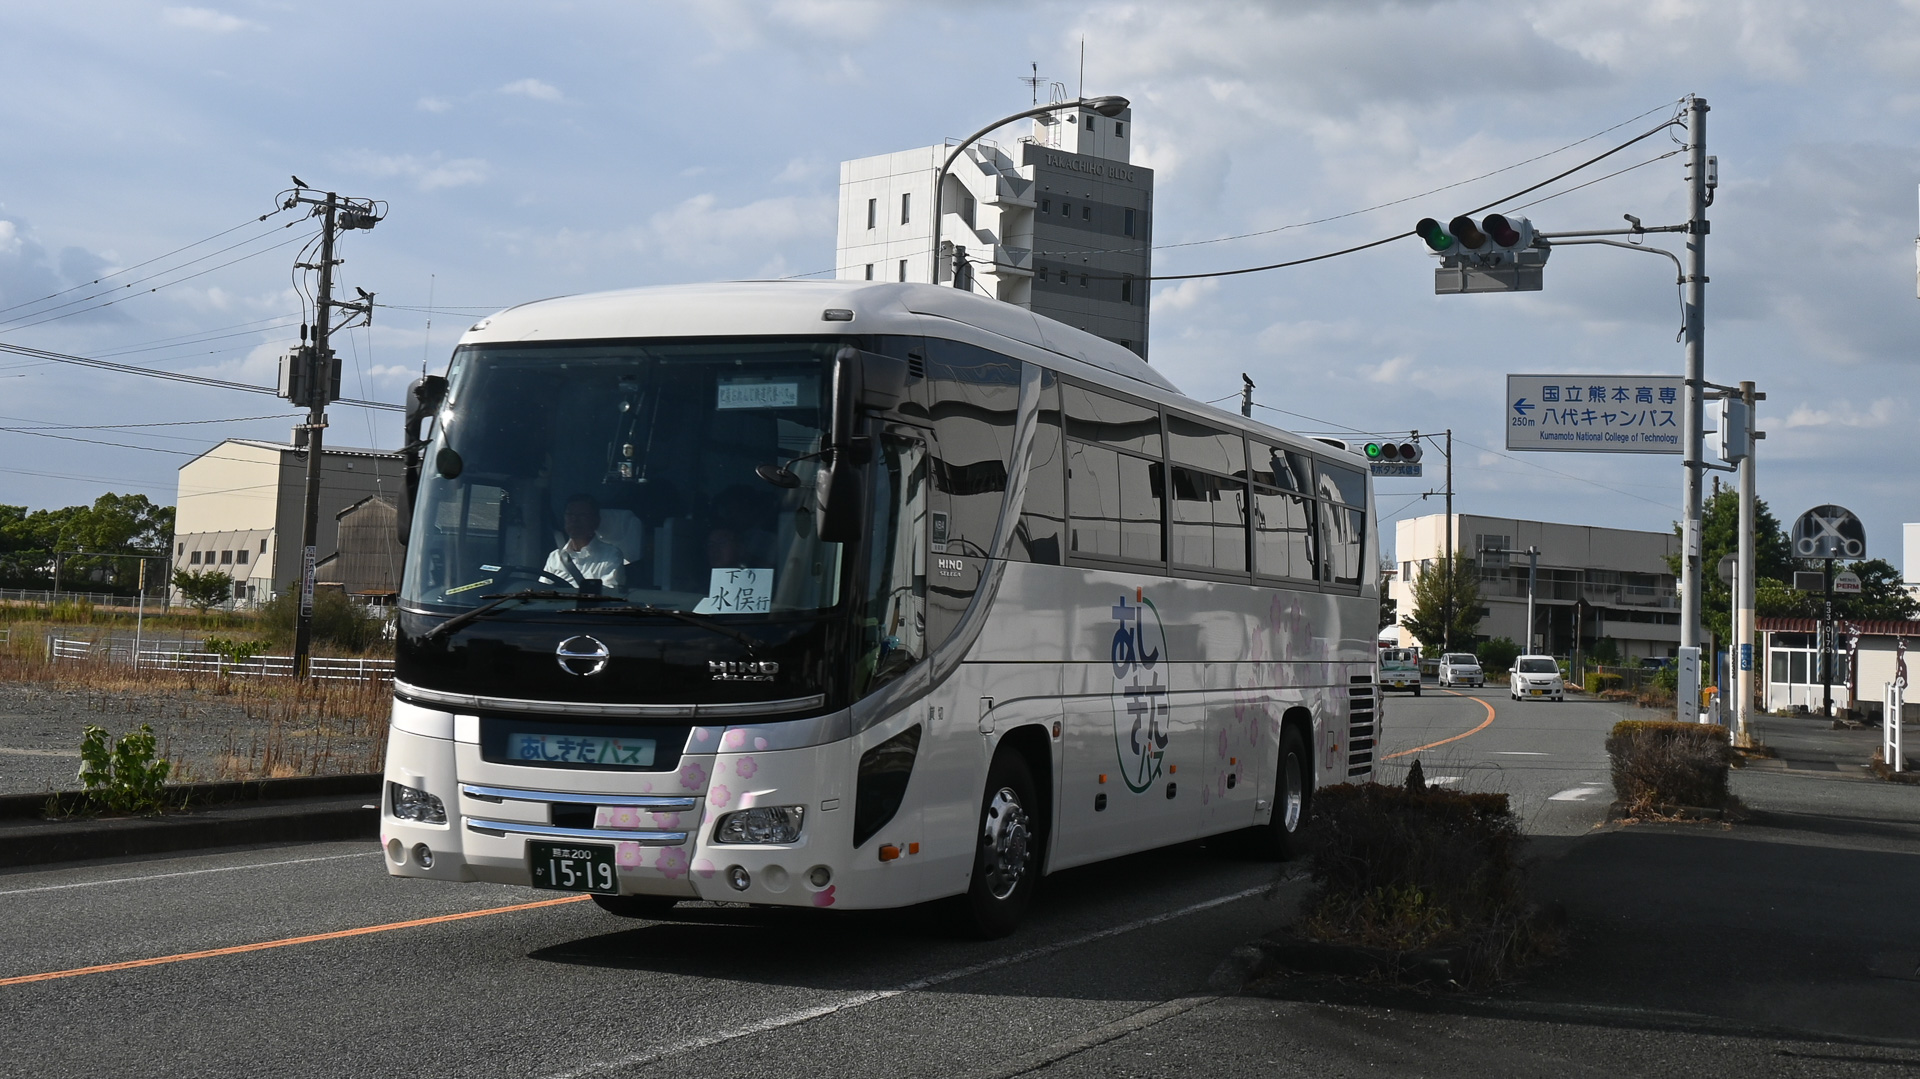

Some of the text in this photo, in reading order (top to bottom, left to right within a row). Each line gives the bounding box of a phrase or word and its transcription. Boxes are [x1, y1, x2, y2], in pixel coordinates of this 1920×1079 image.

[1046, 153, 1135, 182] TAKACHIHO BLDG
[1542, 385, 1677, 405] 国立熊本高専
[1512, 417, 1536, 427] 250m
[1542, 408, 1677, 427] 八代キャンパス
[1540, 431, 1678, 445] Kumamoto National College of Technology
[938, 558, 963, 570] HINO
[725, 570, 756, 584] 下り
[711, 586, 770, 611] 水俣行
[708, 660, 780, 674] HINO
[520, 735, 643, 764] あしきたバス
